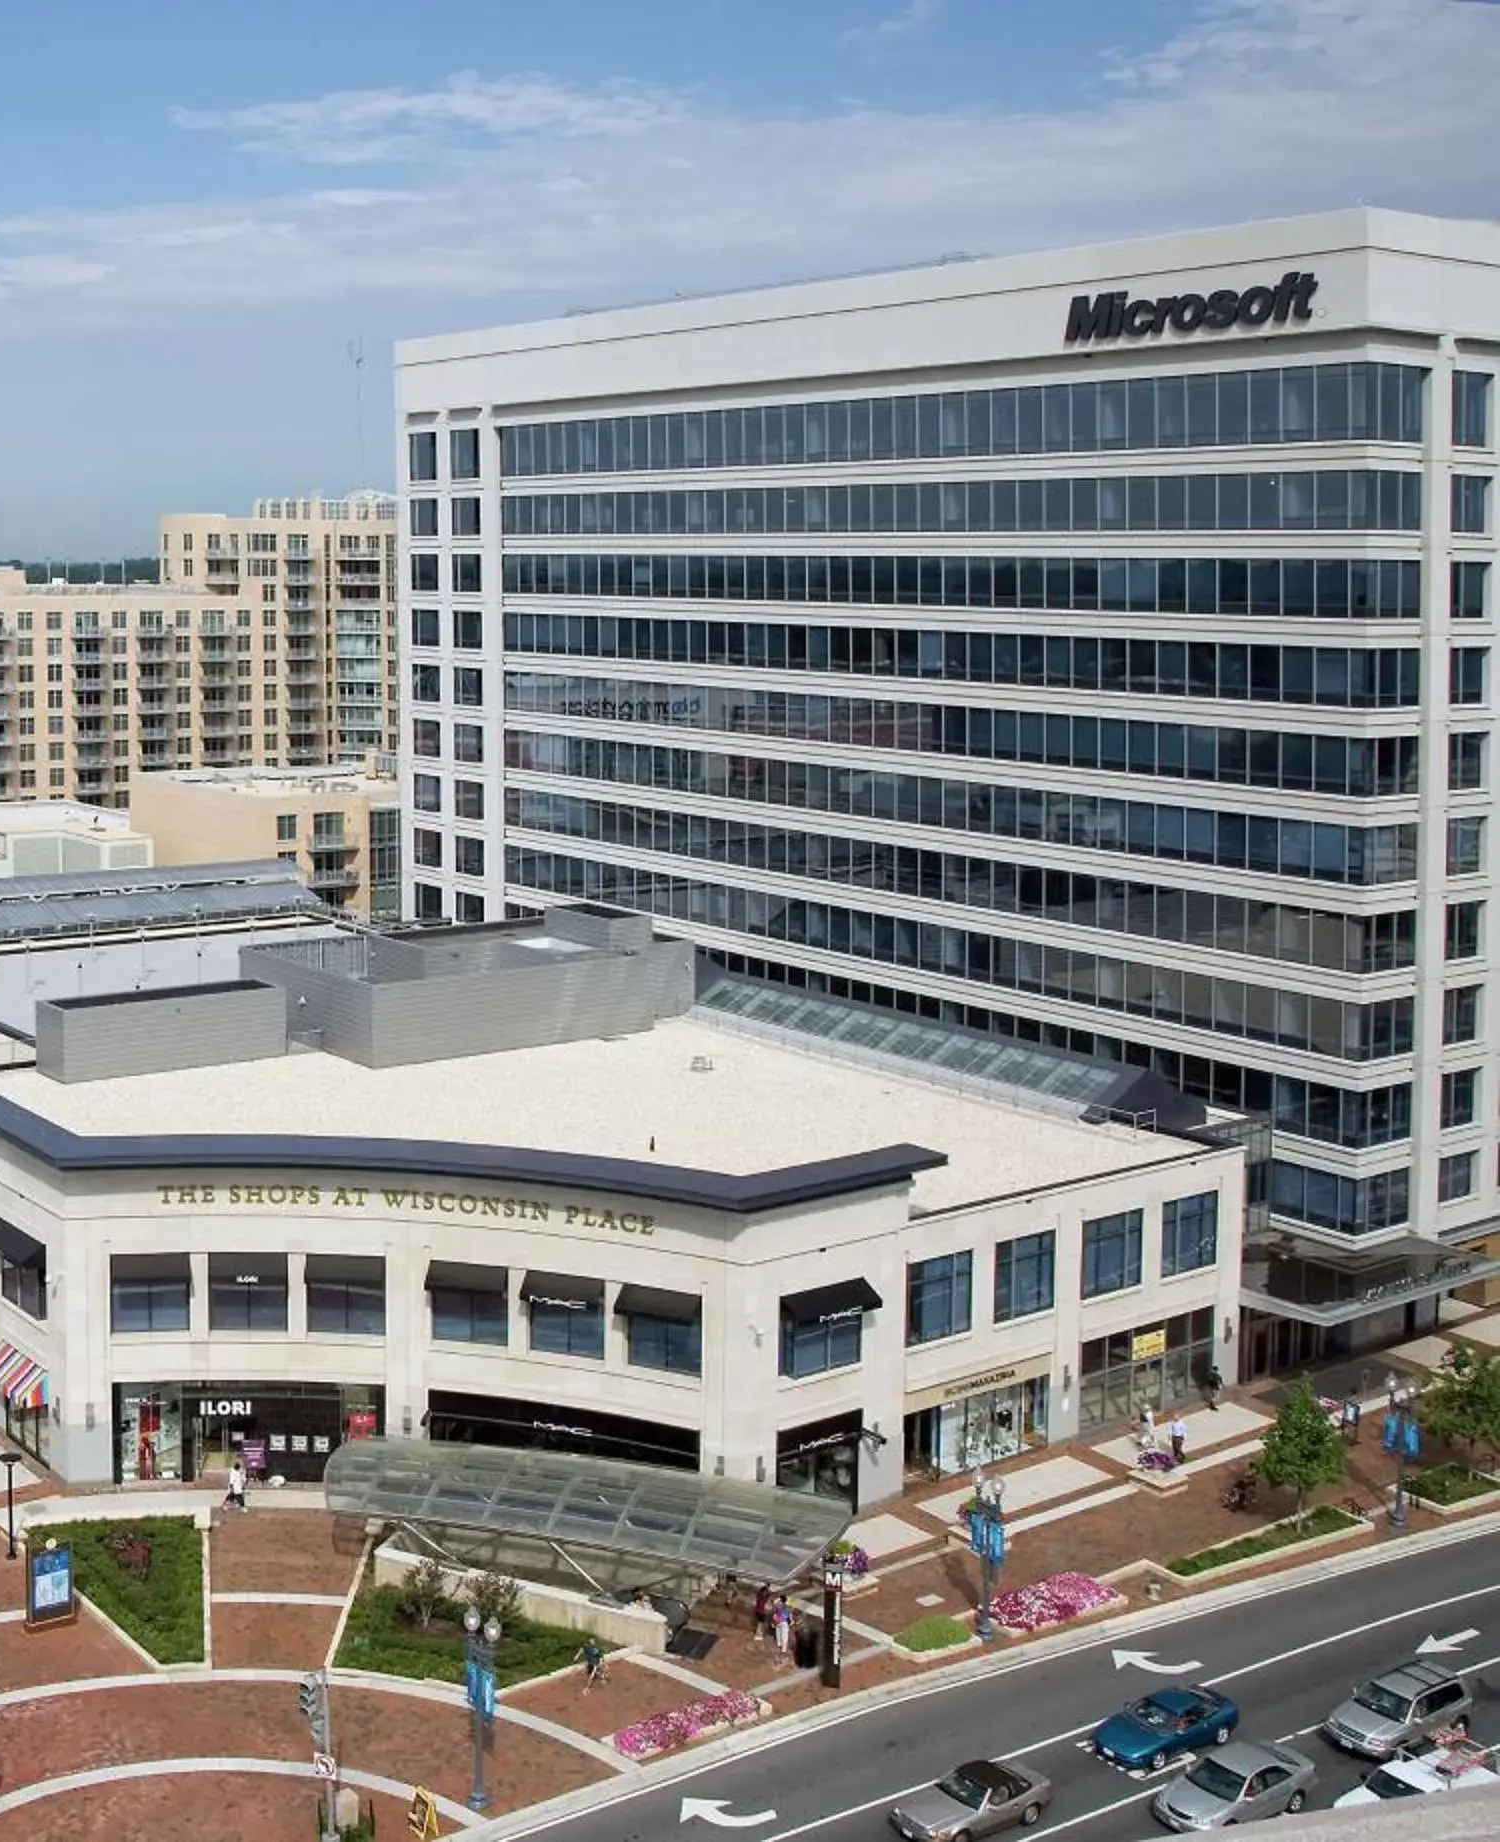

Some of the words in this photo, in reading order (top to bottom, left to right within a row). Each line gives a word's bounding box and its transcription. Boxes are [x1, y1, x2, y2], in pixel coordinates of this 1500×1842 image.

[1064, 272, 1319, 342] Microsoft
[157, 1185, 216, 1205] THE
[229, 1184, 321, 1206] SHOPS
[332, 1186, 368, 1207] AT
[380, 1188, 550, 1222] WISCONSIN
[564, 1204, 657, 1235] PLACE
[200, 1401, 252, 1416] ILORI
[825, 1571, 841, 1587] M
